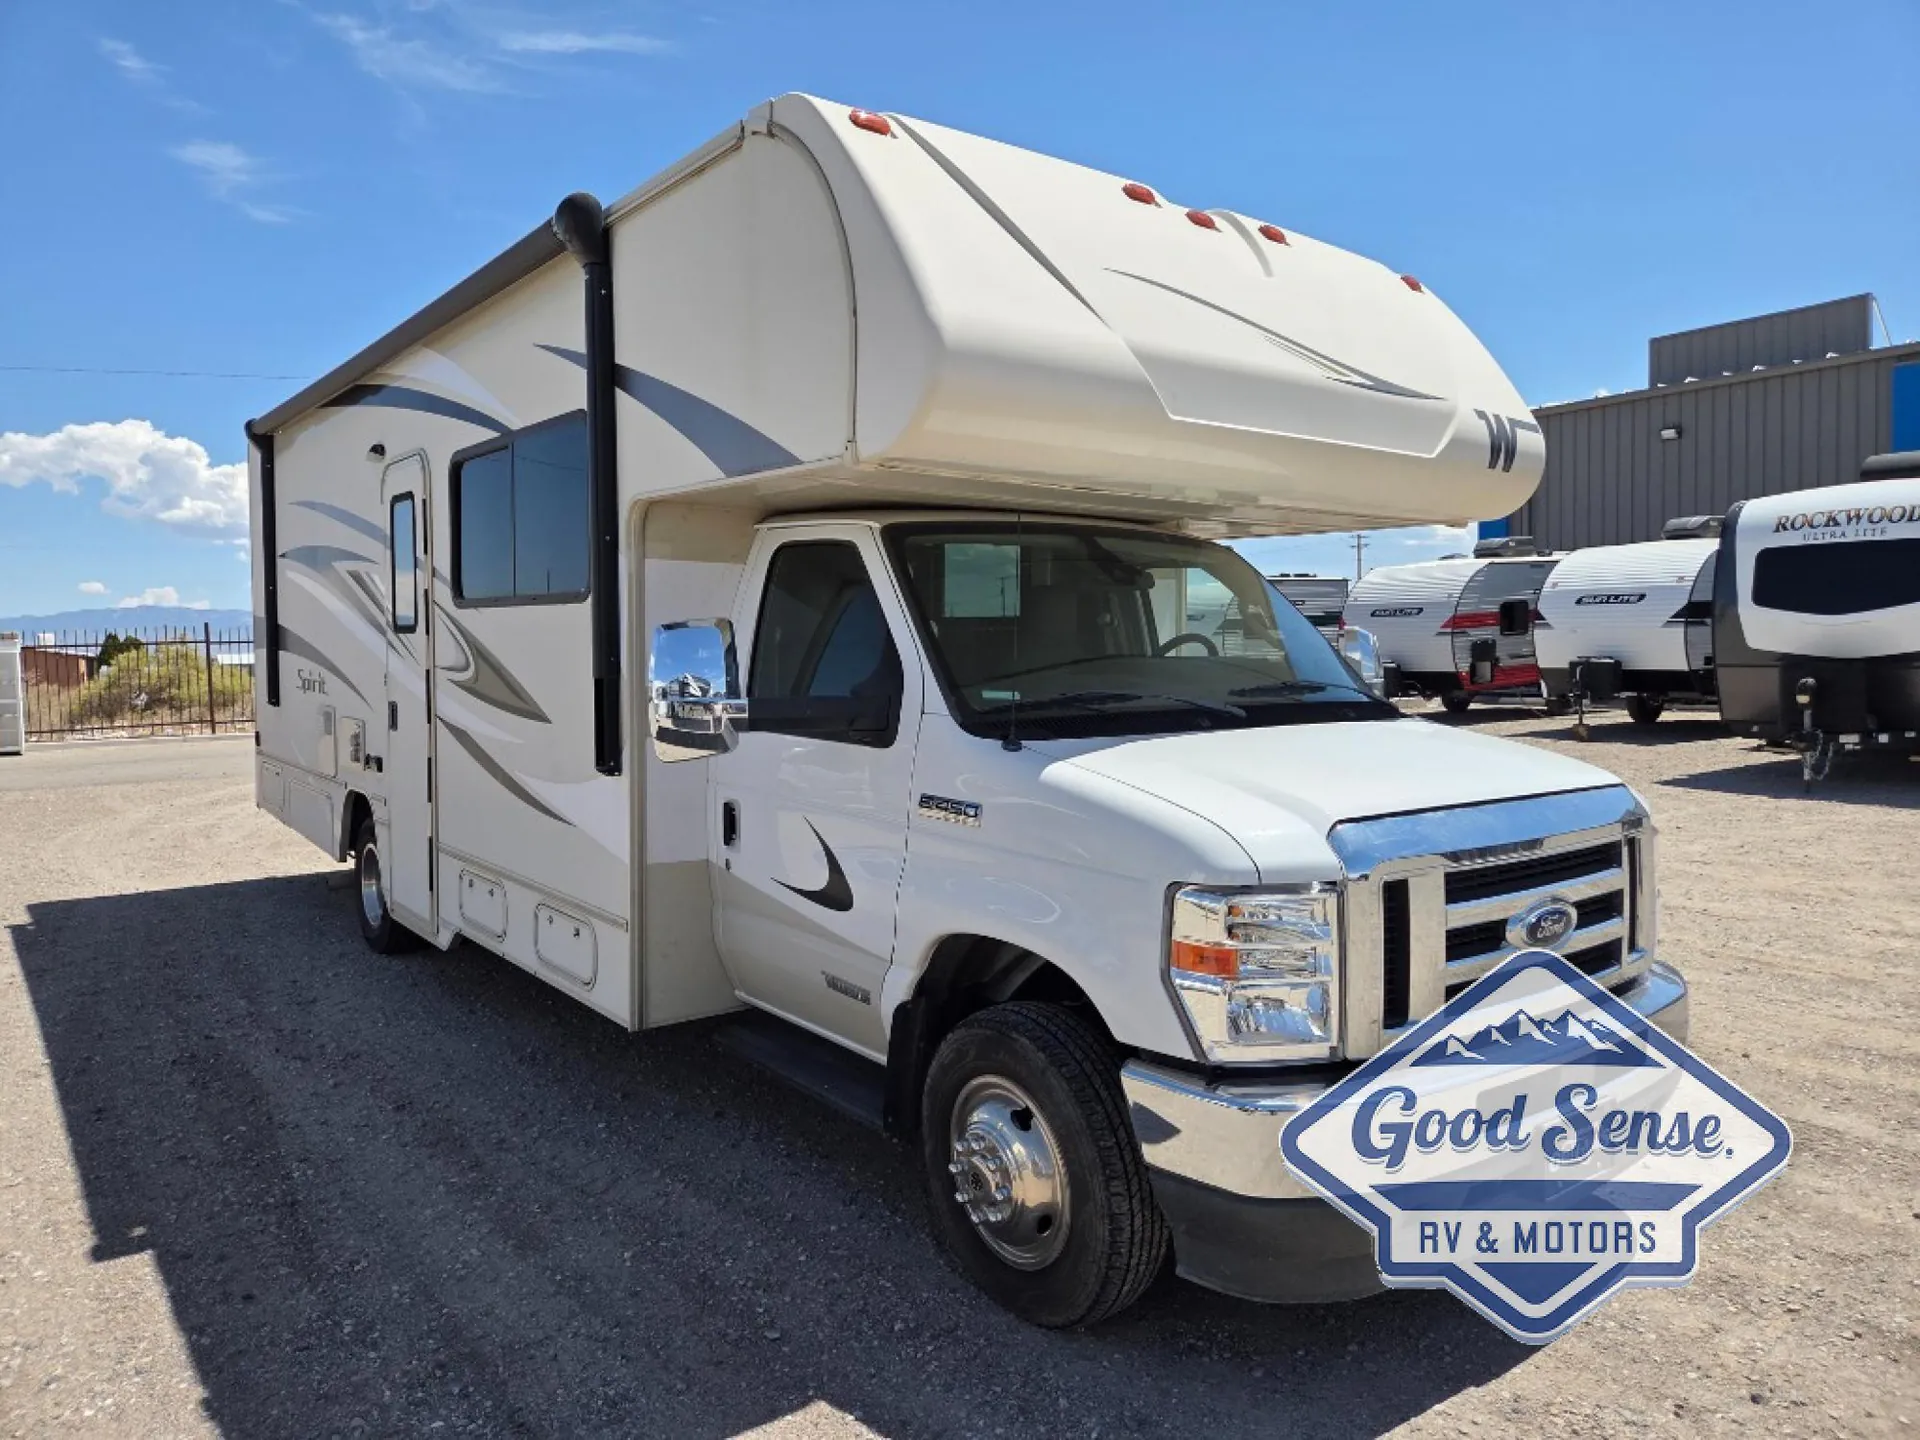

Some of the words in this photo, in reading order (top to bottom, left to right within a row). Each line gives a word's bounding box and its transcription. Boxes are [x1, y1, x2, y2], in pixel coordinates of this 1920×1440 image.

[1773, 504, 1920, 533] ROCKWOOD
[1802, 531, 1848, 541] ULTRA
[1853, 526, 1888, 538] LITE
